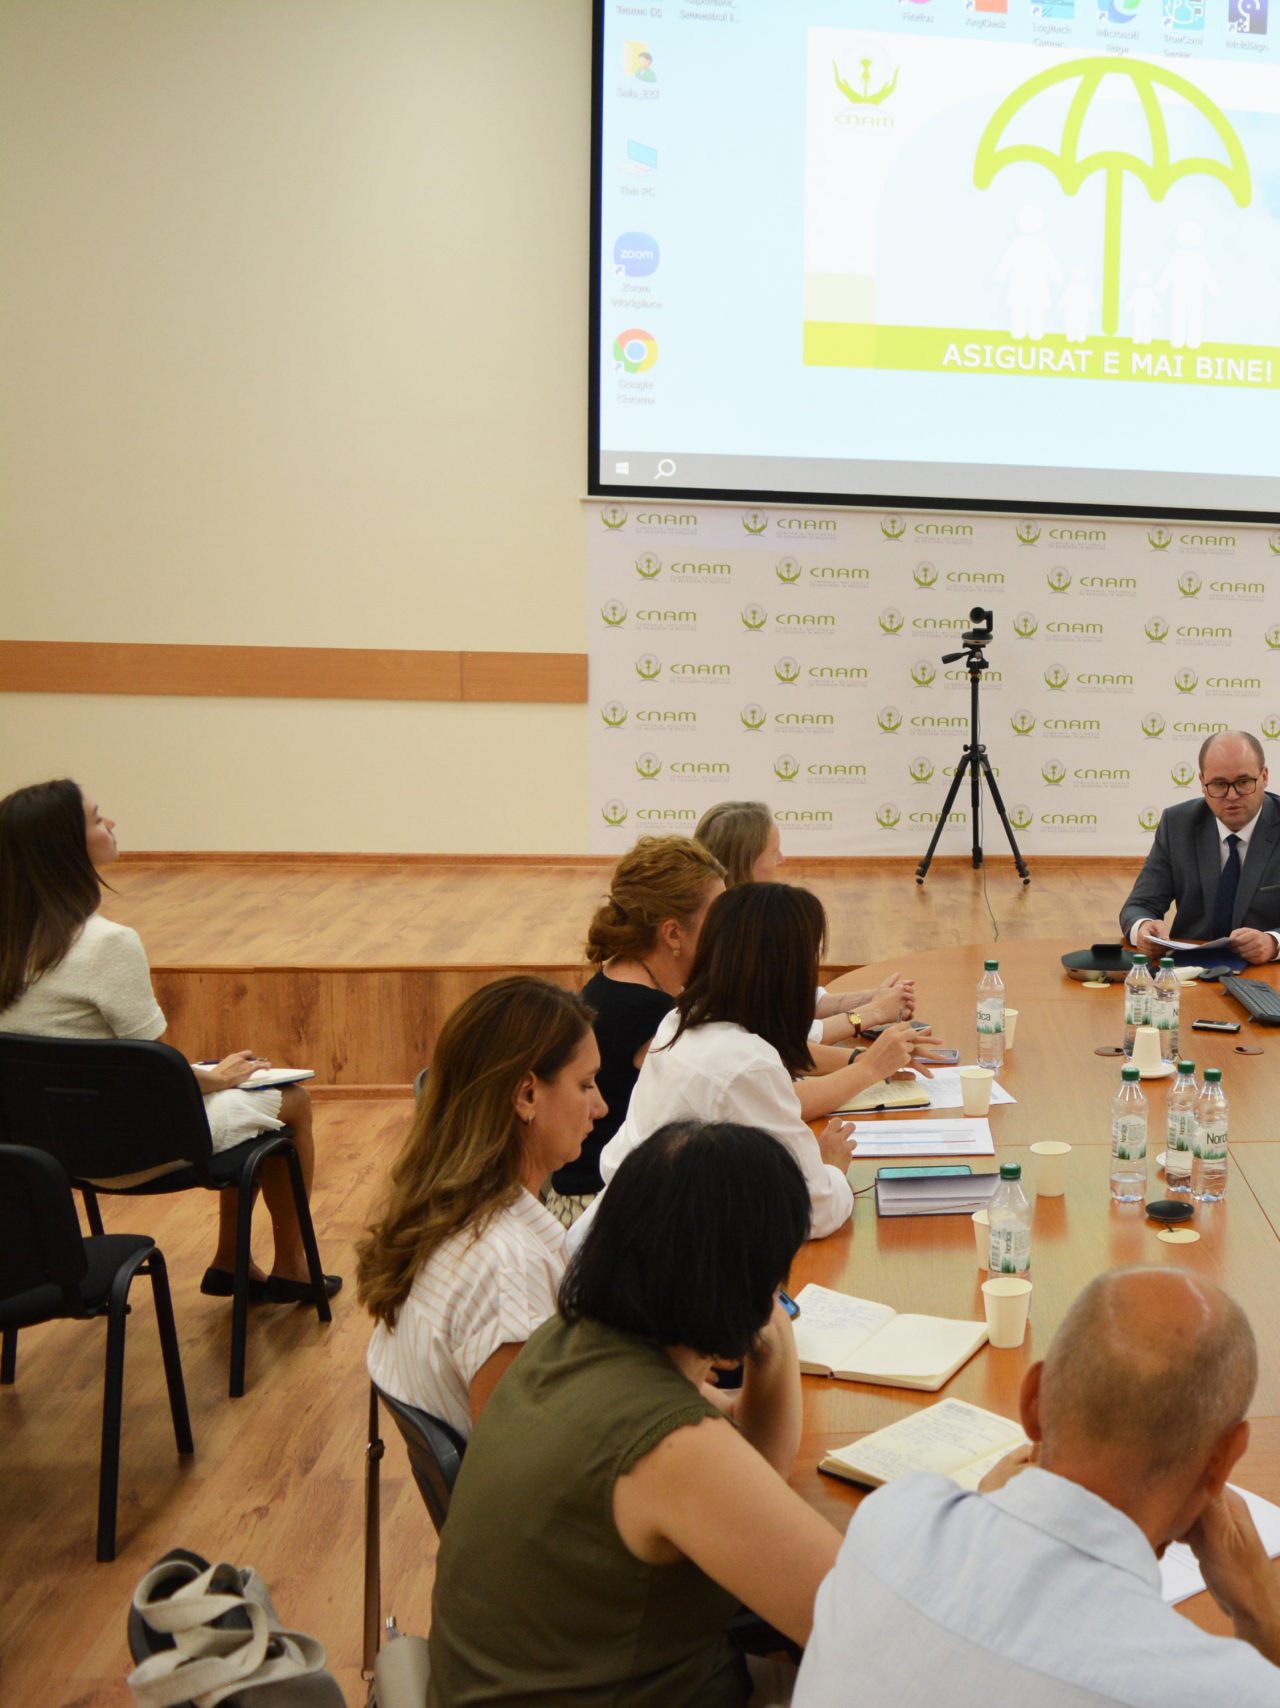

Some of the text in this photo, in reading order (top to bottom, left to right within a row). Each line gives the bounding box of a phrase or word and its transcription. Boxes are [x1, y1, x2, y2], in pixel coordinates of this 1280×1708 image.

[620, 249, 654, 260] zoom
[943, 343, 1273, 383] ASIGURAT E MAI BINE!
